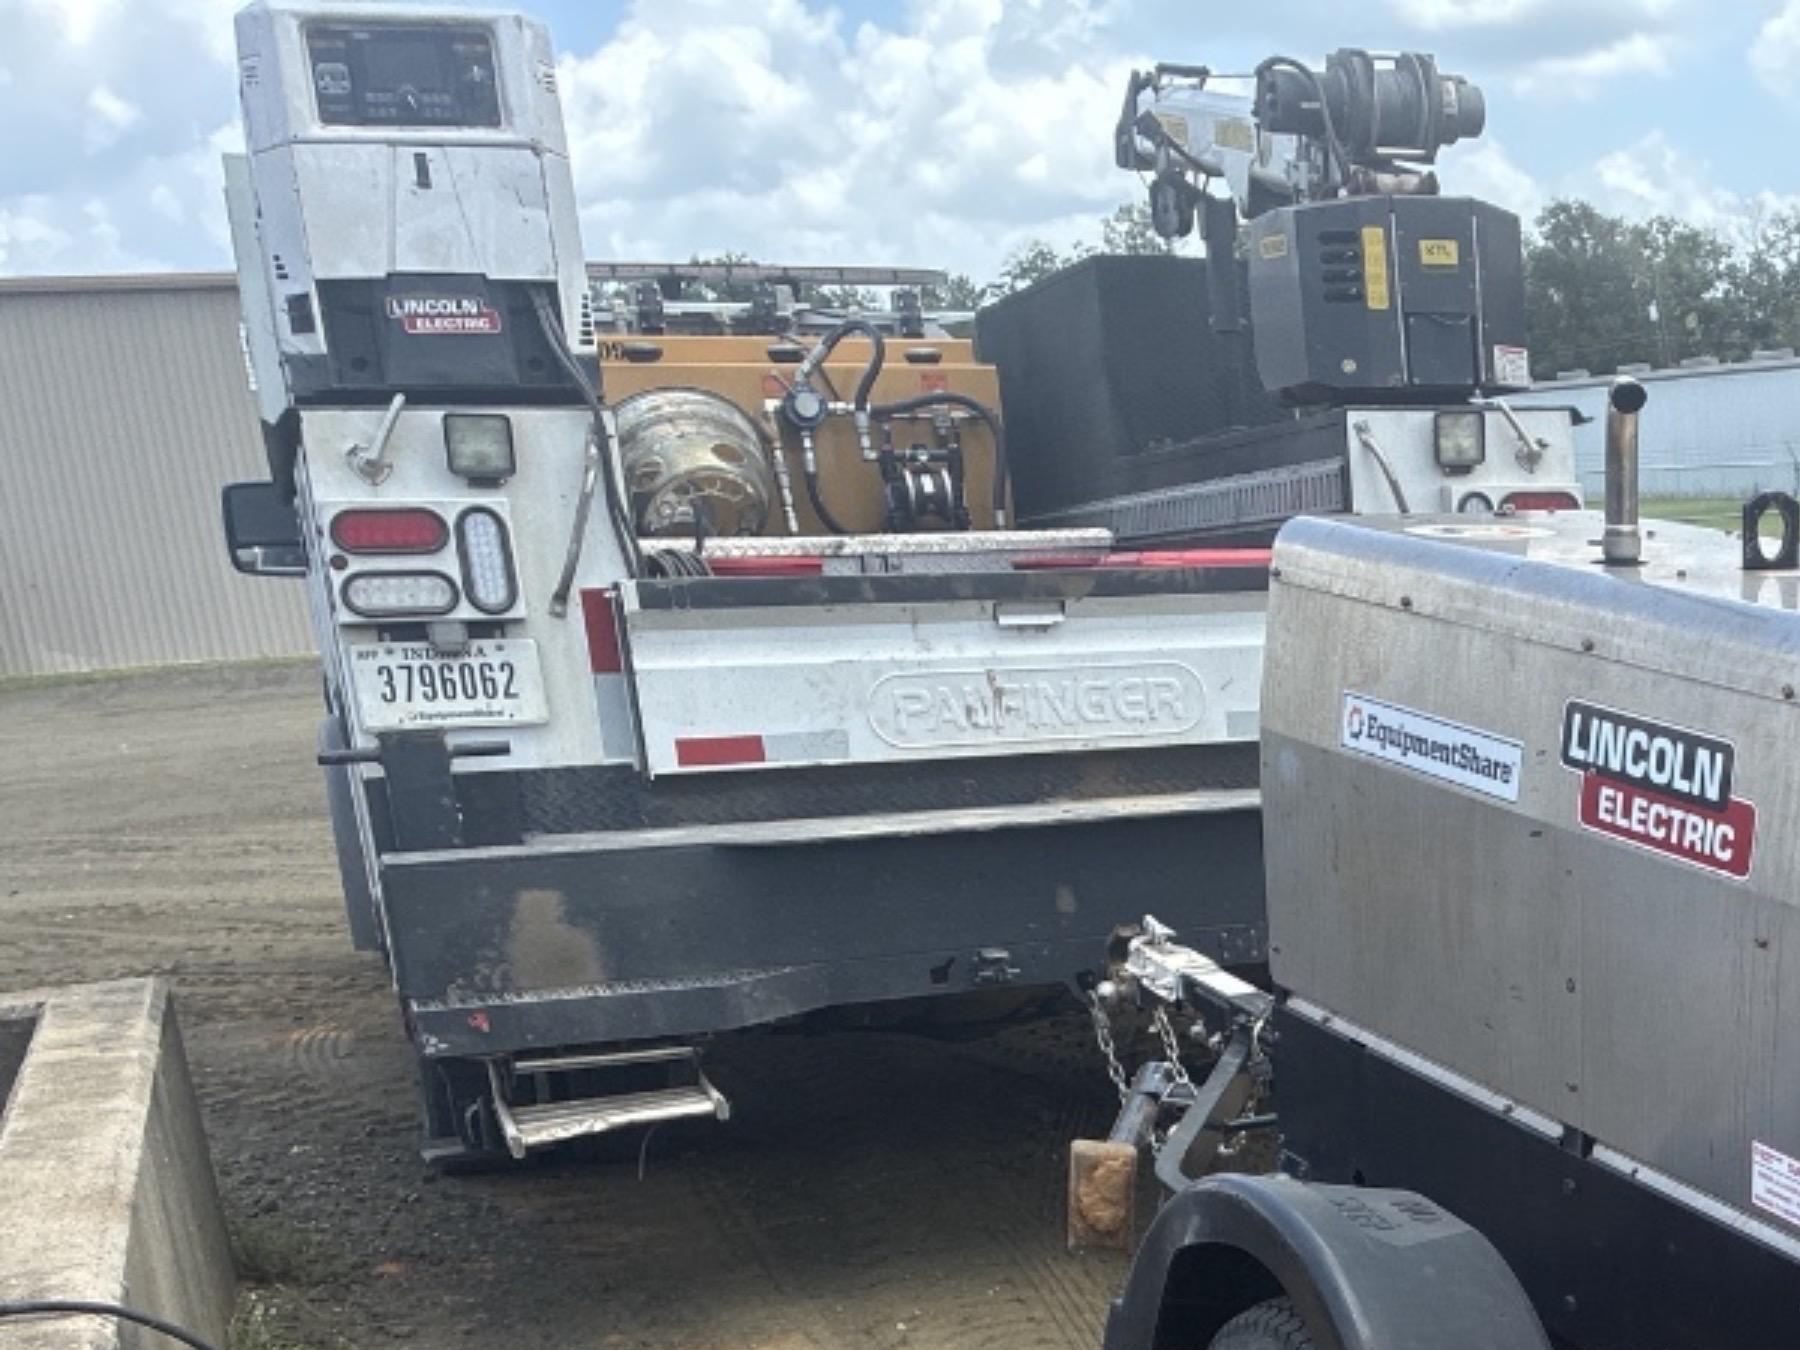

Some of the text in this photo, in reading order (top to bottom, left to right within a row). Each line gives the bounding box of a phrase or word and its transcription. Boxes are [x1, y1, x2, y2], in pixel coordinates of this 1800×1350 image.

[391, 298, 480, 316] LINCOLN
[415, 317, 492, 331] ELECTRIC
[377, 662, 519, 703] 3796062
[1366, 713, 1515, 785] EquipmentShare
[1568, 713, 1724, 802] LINCOLN
[1597, 785, 1736, 863] ELECTRIC
